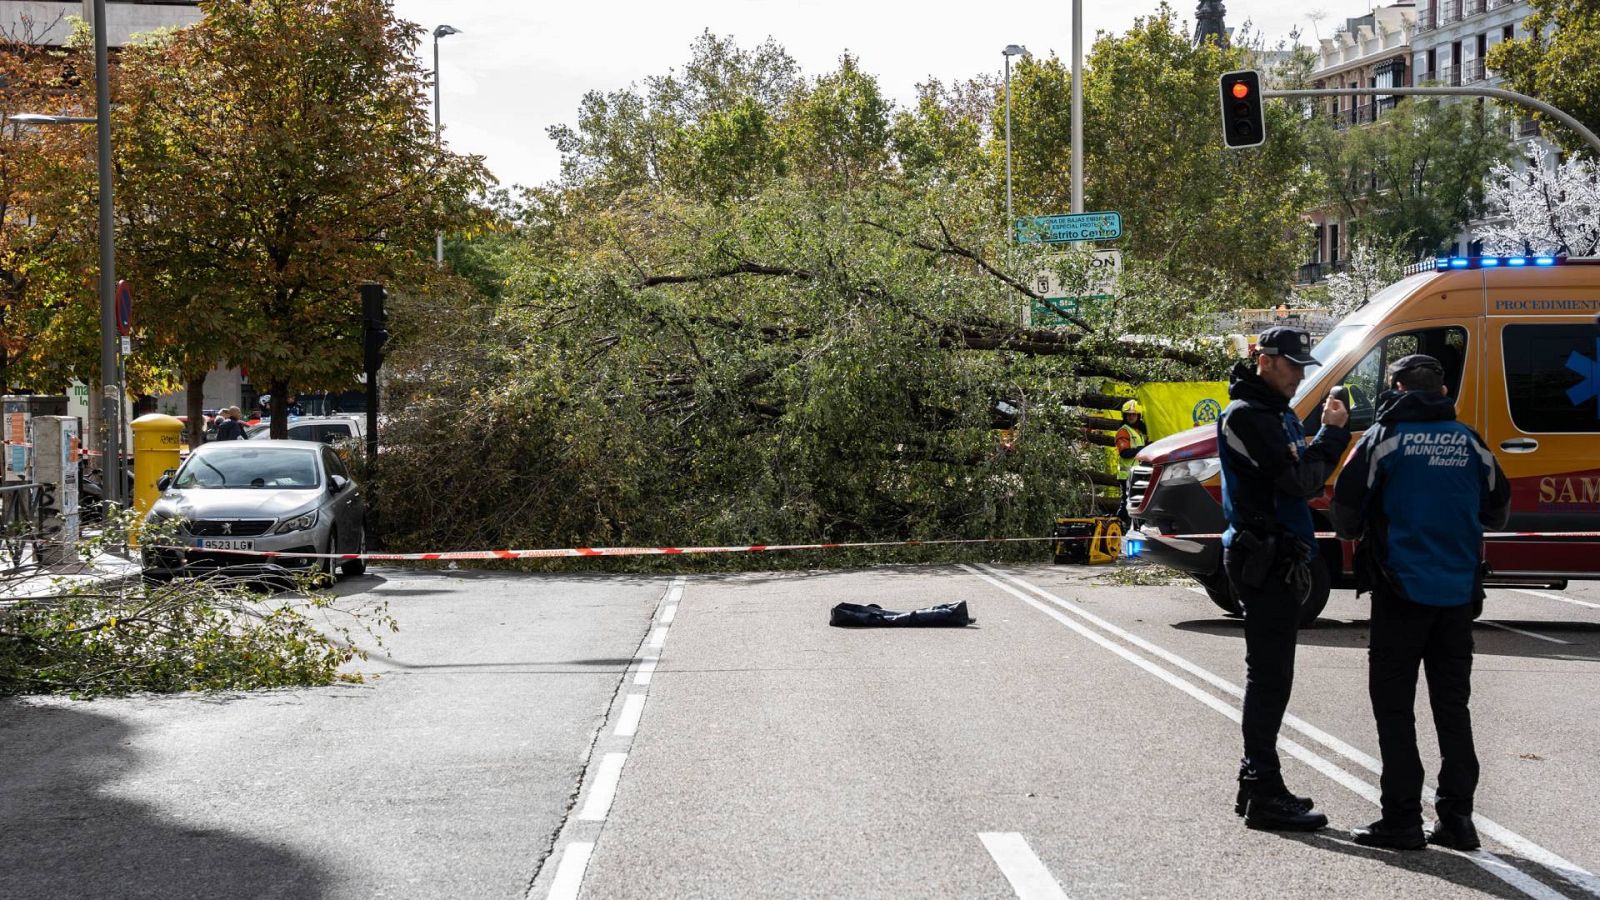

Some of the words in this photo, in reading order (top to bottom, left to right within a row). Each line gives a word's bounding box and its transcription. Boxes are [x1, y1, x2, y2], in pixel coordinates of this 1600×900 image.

[1049, 230, 1079, 240] strito
[1081, 229, 1117, 238] Cenro
[1496, 299, 1600, 310] PROCEDIMIENT
[1402, 431, 1467, 445] POLICÍA
[1404, 445, 1469, 457] MUNICIPAL
[1428, 456, 1469, 467] Madrid
[205, 541, 230, 550] 9523
